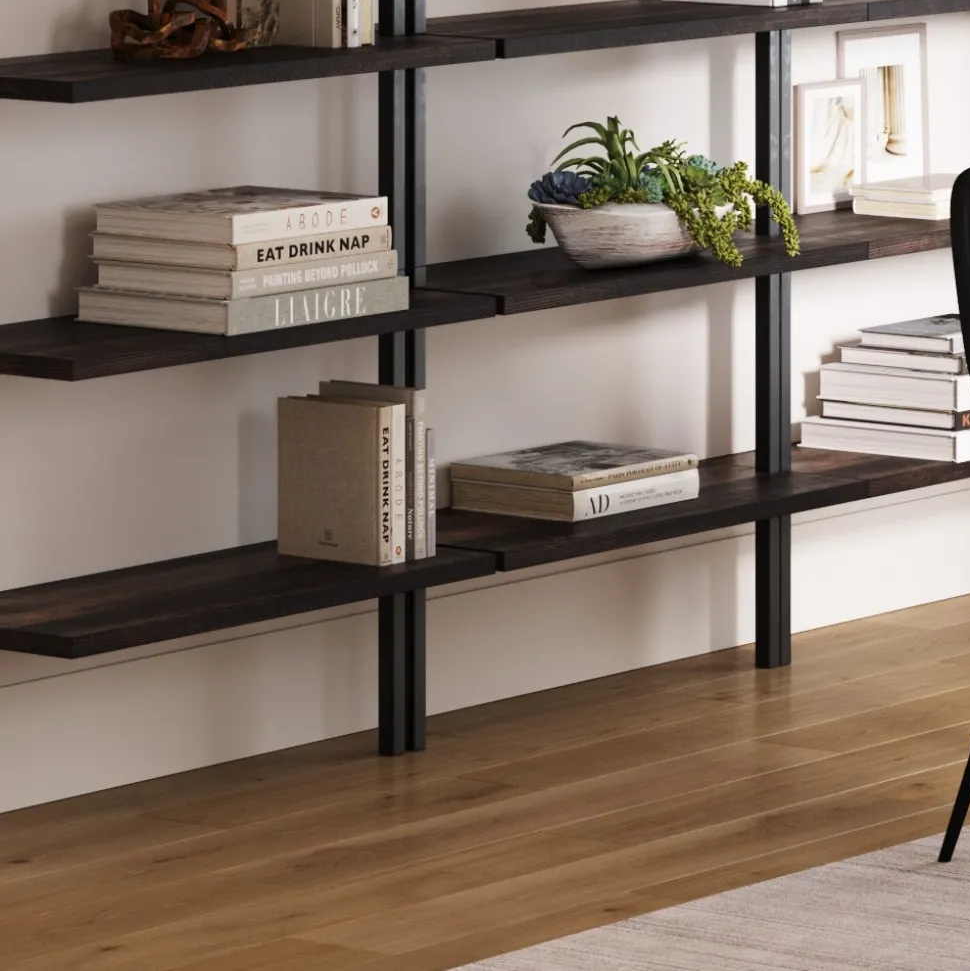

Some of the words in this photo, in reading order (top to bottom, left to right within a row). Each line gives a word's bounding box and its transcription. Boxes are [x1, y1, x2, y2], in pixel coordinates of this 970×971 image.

[285, 207, 348, 231] ABODE
[256, 246, 285, 263] EAT
[288, 239, 336, 259] DRINK
[339, 234, 371, 252] NAP
[262, 273, 303, 288] PAINTING
[304, 266, 340, 283] BEYOND
[340, 259, 380, 277] POLLOCK
[274, 286, 367, 327] LIAIGRE
[382, 426, 390, 455] EAT
[382, 459, 390, 508] DRINK
[394, 458, 402, 522] ABODE
[584, 492, 611, 517] AD
[382, 511, 390, 545] NAP
